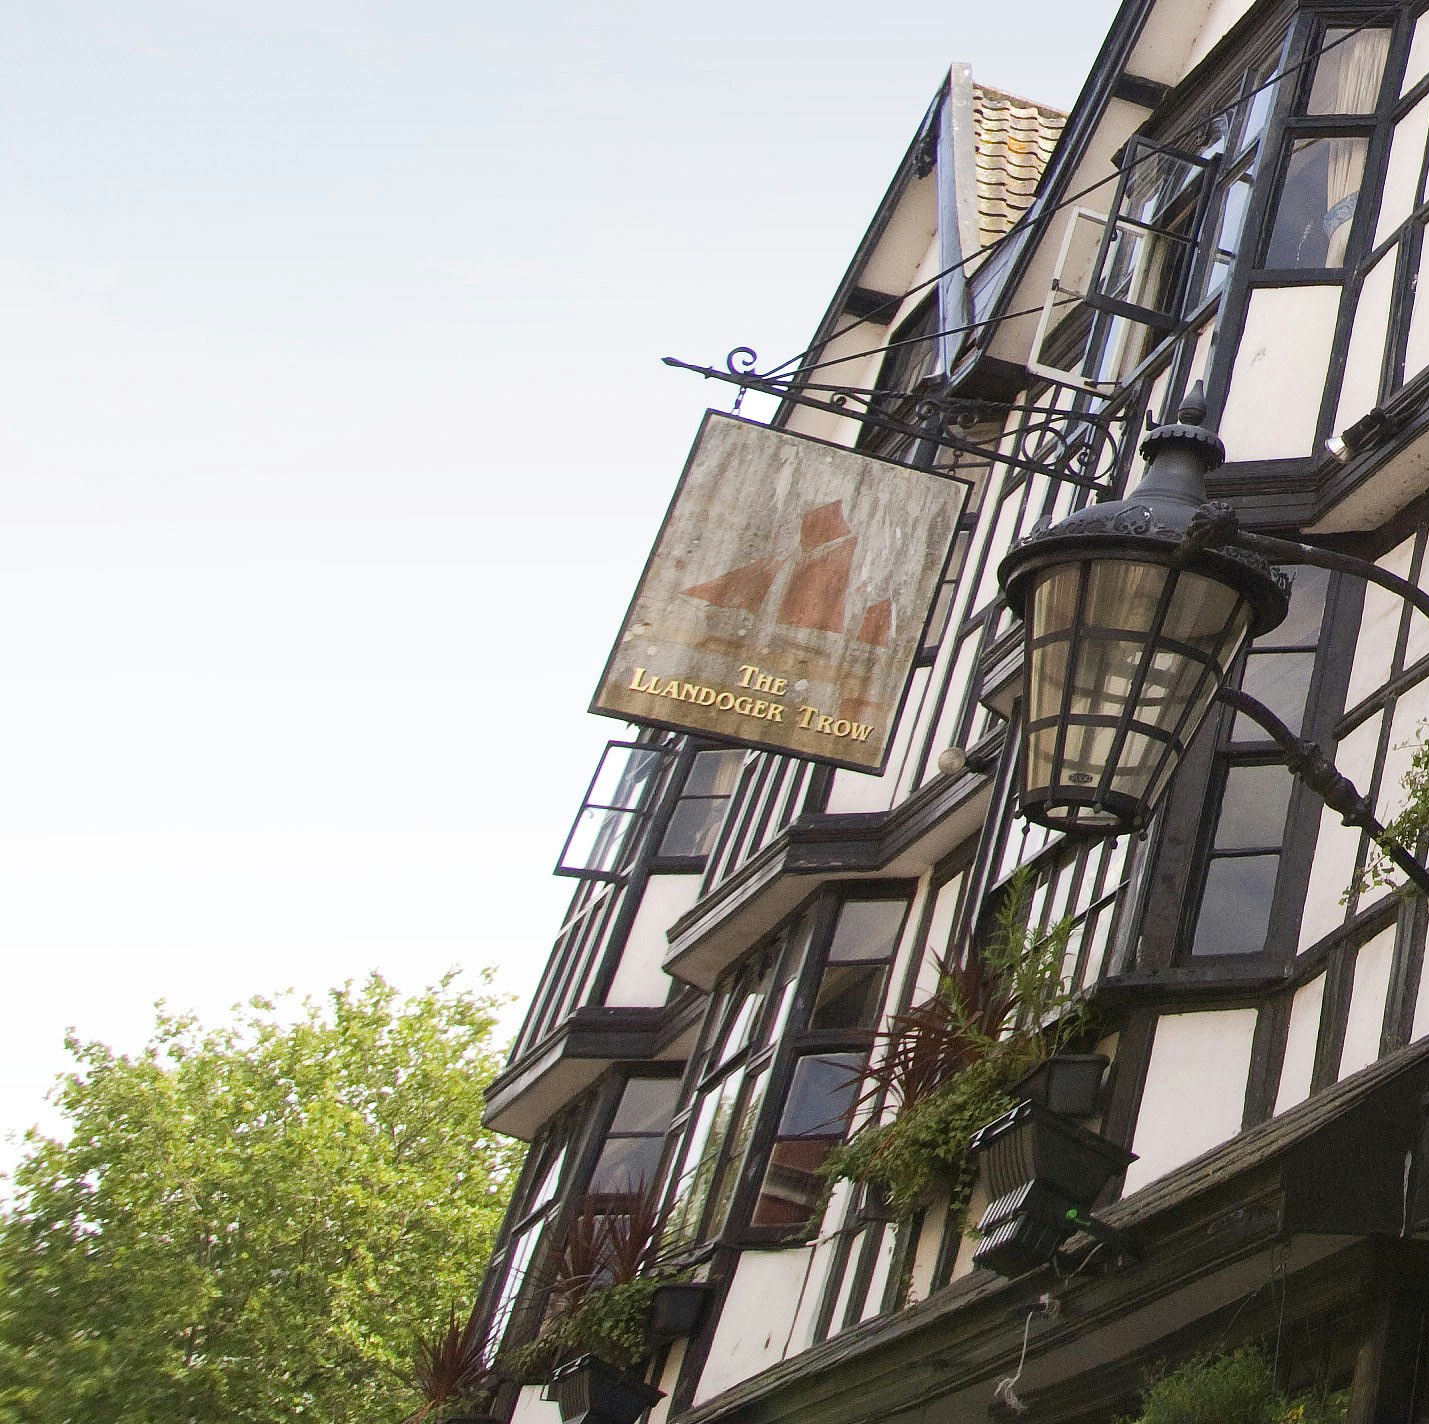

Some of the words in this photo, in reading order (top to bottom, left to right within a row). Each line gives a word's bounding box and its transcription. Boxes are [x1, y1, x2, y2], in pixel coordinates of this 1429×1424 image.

[629, 666, 785, 722] LLANDOGER
[798, 704, 874, 742] TROW
[738, 664, 788, 696] THE
